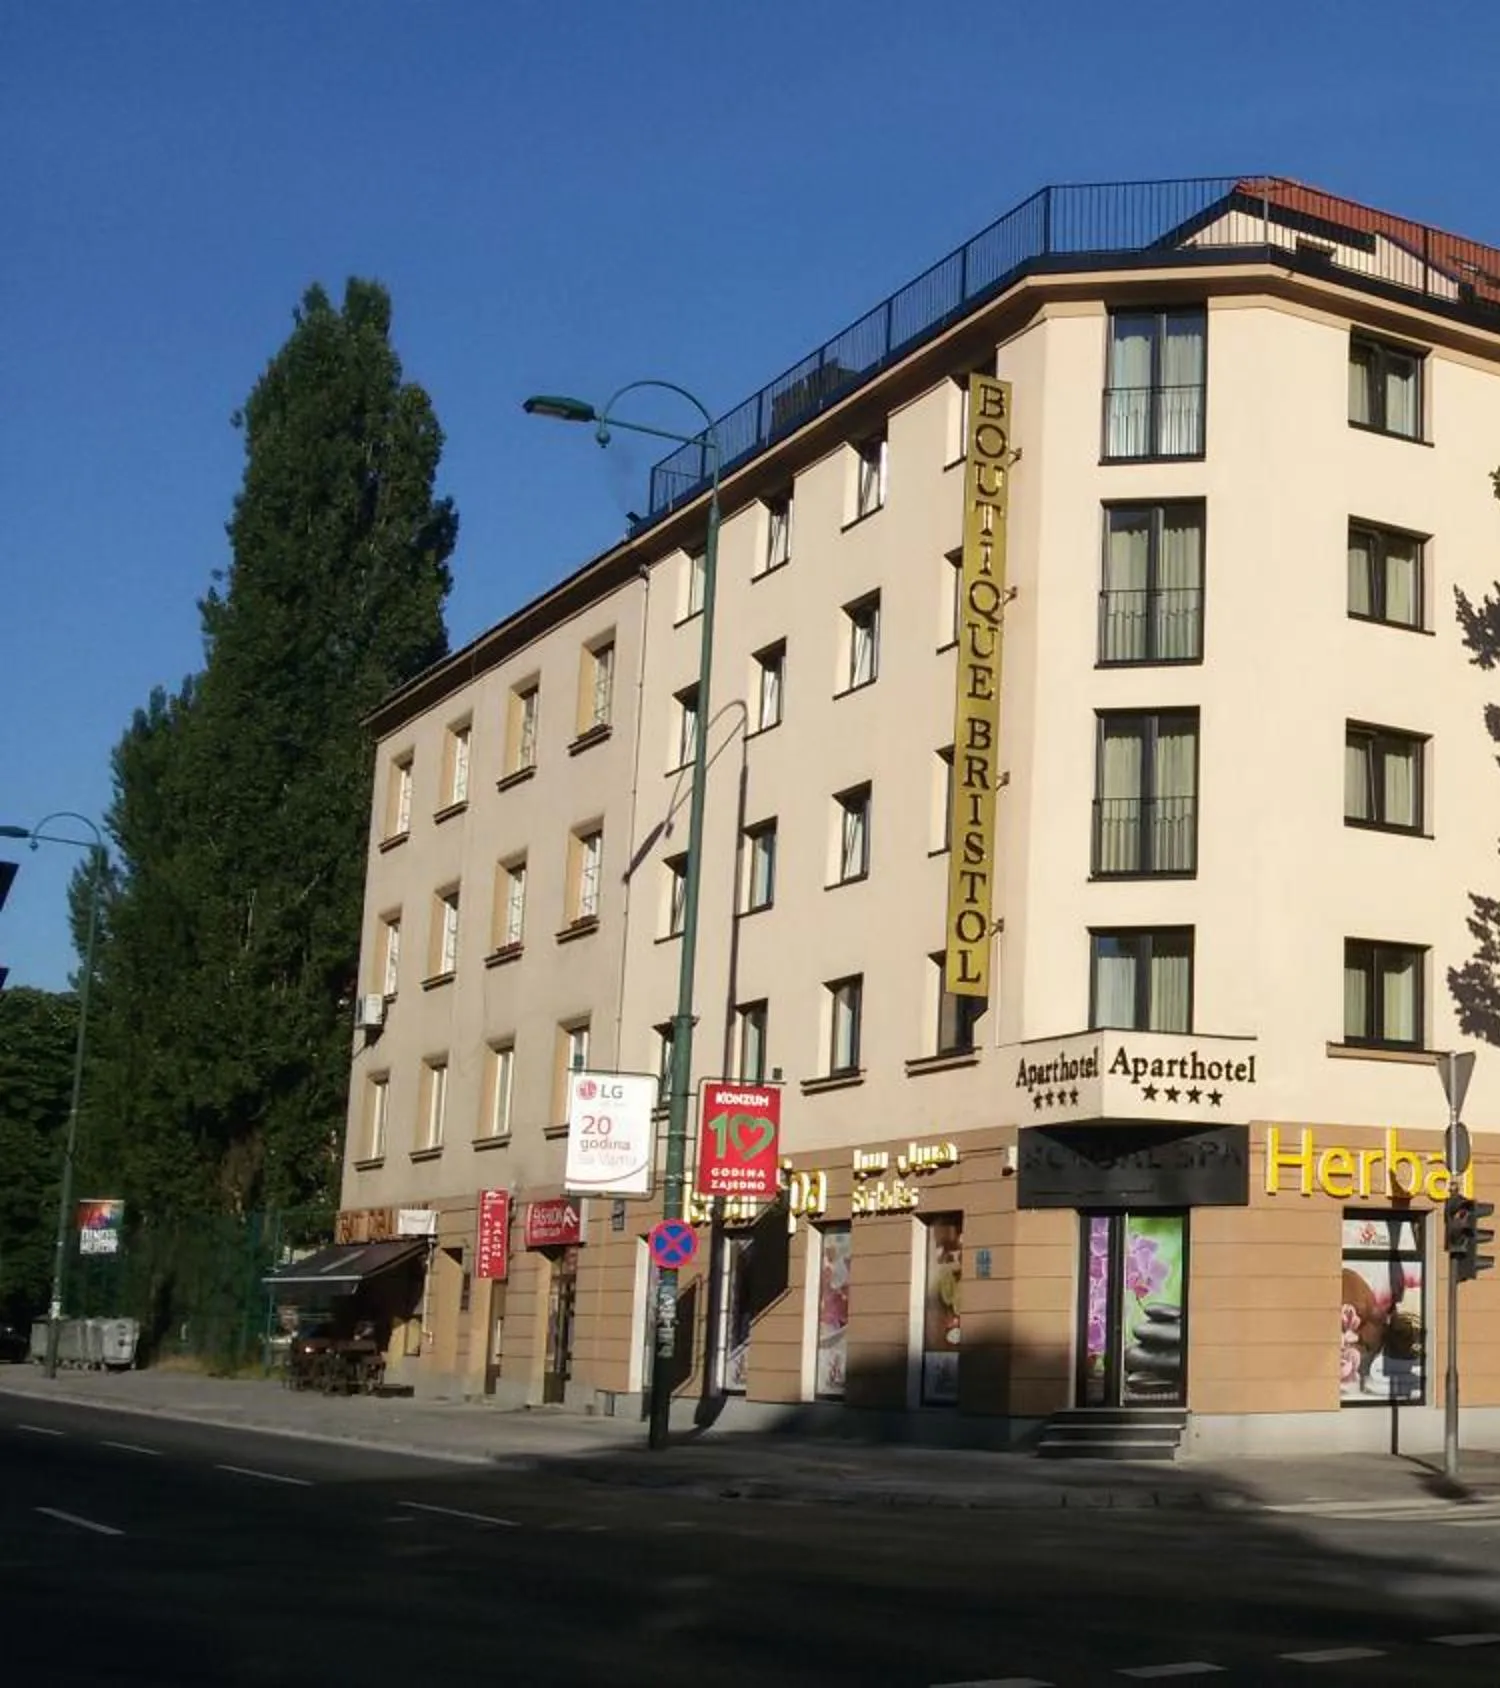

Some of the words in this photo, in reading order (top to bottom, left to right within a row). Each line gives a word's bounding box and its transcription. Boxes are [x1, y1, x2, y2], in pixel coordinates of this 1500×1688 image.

[967, 383, 1008, 700] BOUTIQUE
[955, 716, 992, 985] BRISTOL
[1015, 1045, 1099, 1092] Aparthotel
[1108, 1046, 1257, 1084] Aparthotel
[600, 1084, 624, 1099] LG
[715, 1092, 769, 1107] KONZUM
[580, 1115, 612, 1135] 20
[580, 1137, 631, 1152] godina
[711, 1167, 766, 1178] GODINA
[1265, 1127, 1474, 1202] Herbal
[711, 1179, 766, 1191] ZAJEDNO
